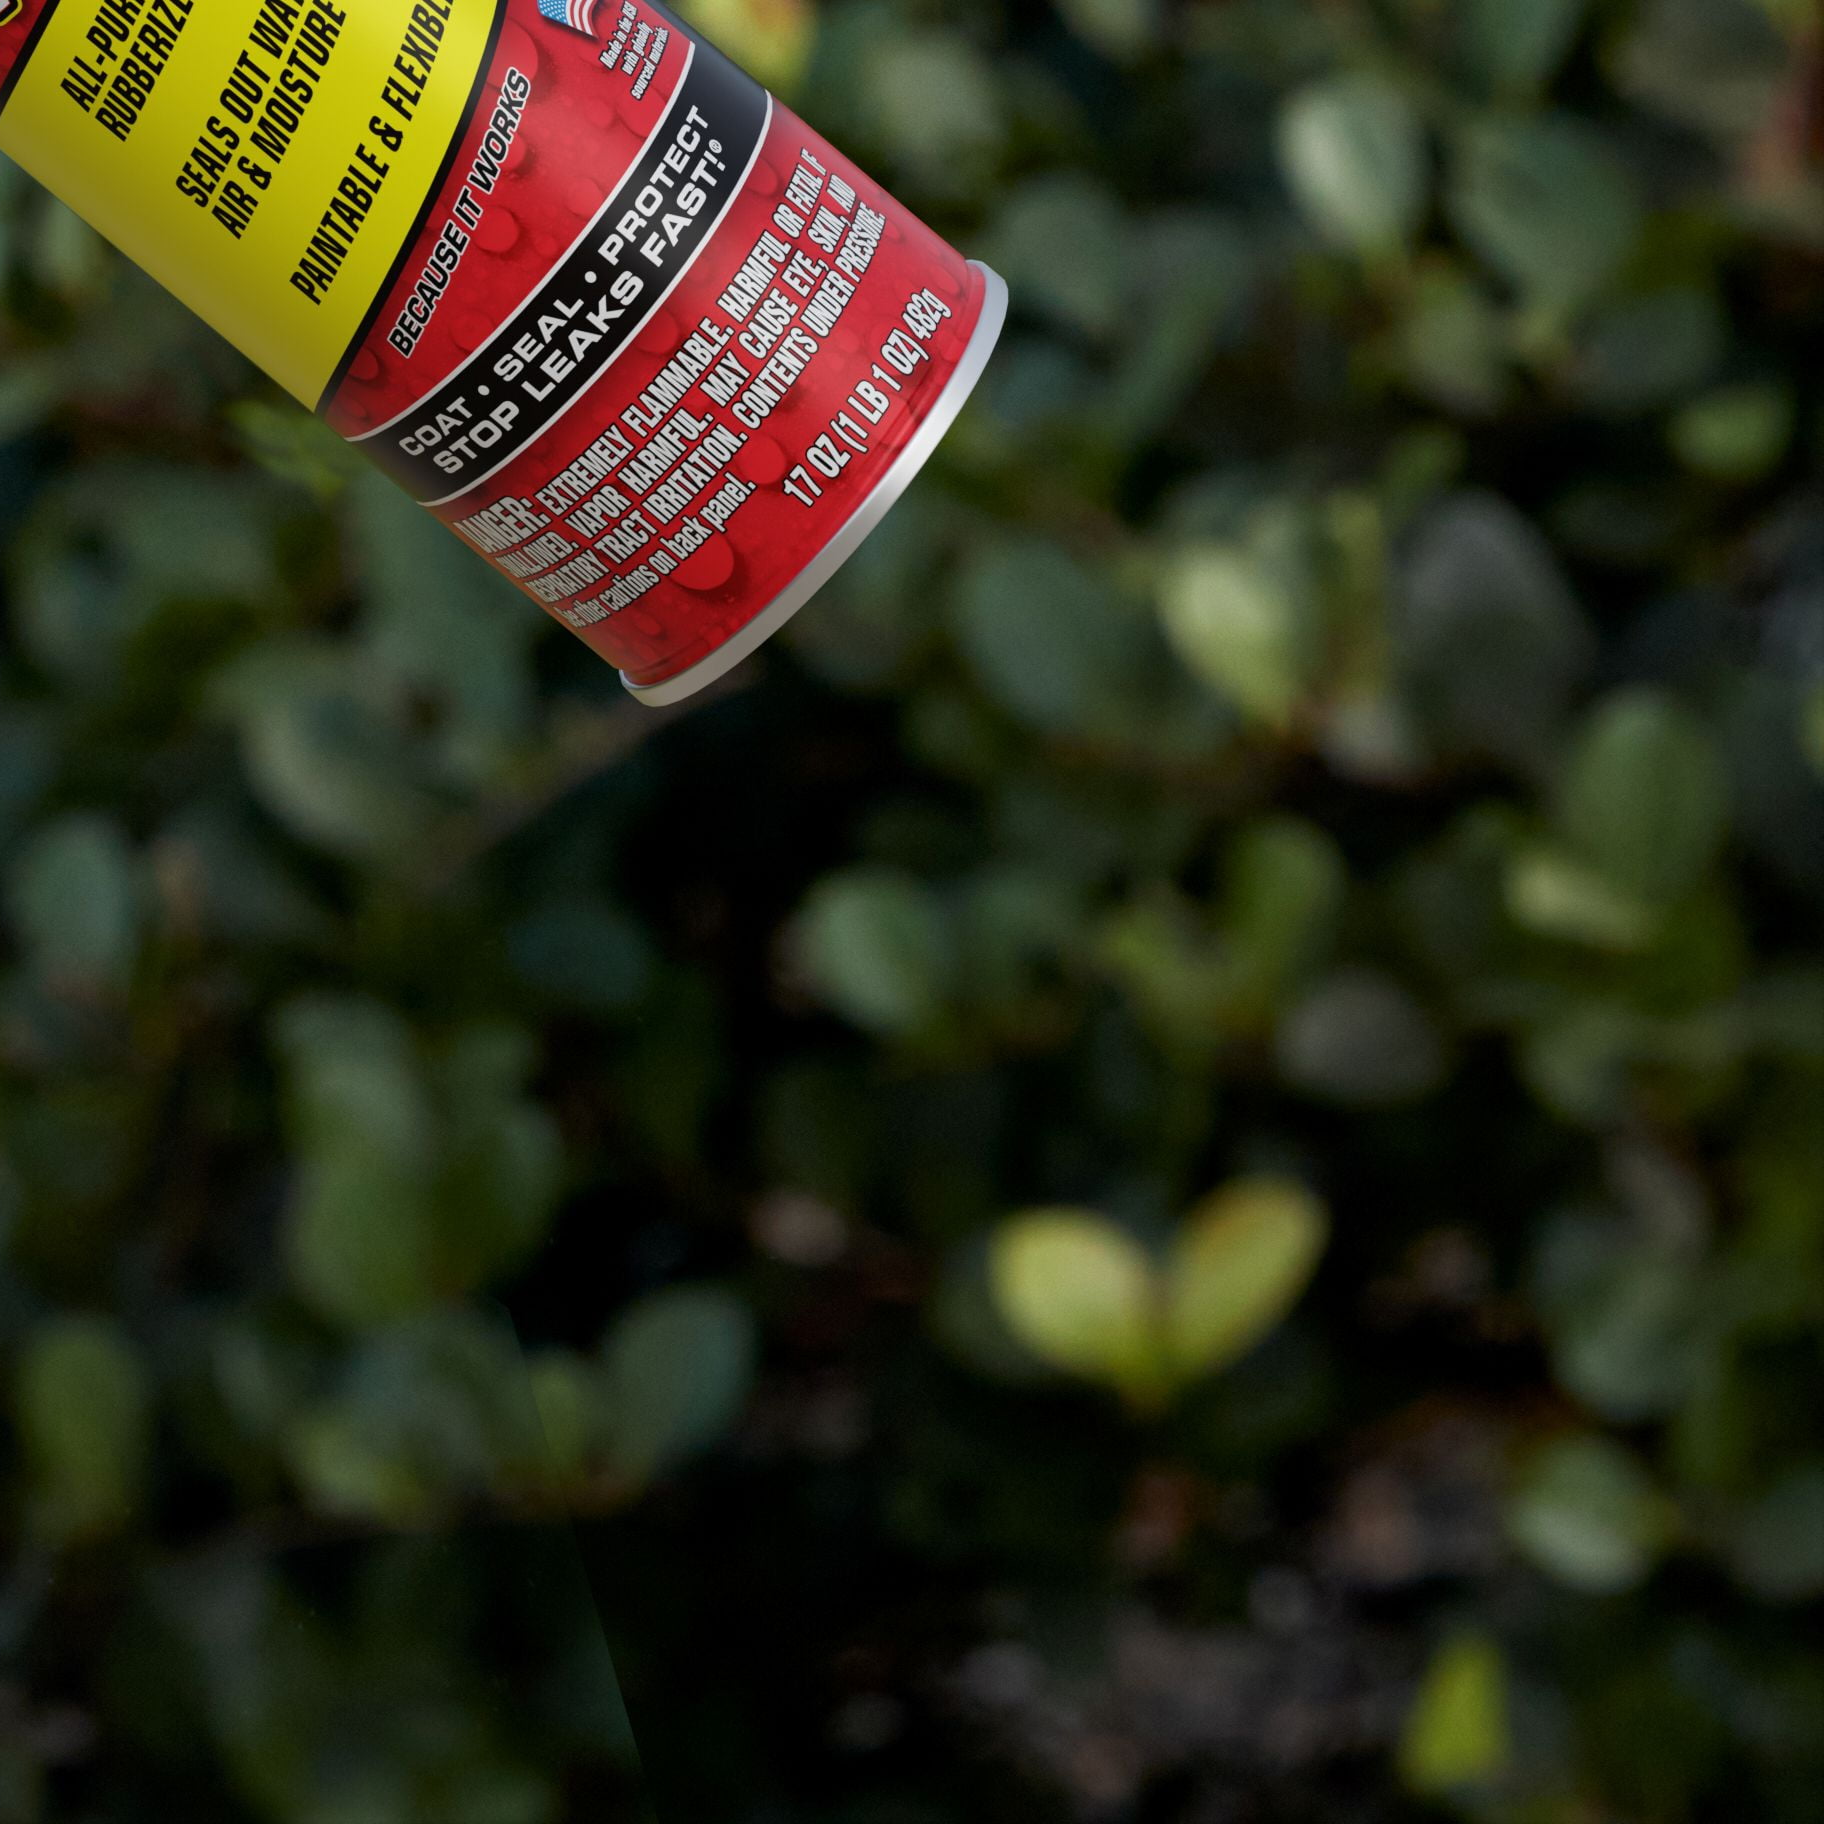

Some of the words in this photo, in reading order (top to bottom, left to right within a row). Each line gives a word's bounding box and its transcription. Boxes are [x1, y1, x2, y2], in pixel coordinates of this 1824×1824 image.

[612, 30, 628, 44] in
[617, 16, 633, 34] the
[630, 20, 654, 57] globally
[598, 39, 623, 70] Made
[621, 49, 640, 76] with
[631, 57, 657, 100] sourced
[175, 115, 240, 209] SEALS
[219, 49, 272, 124] OUT
[469, 66, 532, 196] WORKS
[800, 147, 827, 177] IF
[210, 186, 260, 241] AIR
[236, 155, 274, 191] &
[289, 142, 391, 306] PAINTABLE
[367, 115, 405, 153] &
[455, 188, 484, 234] IT
[783, 163, 825, 216] FATAL
[826, 173, 857, 216] AND
[771, 202, 806, 239] OR
[806, 204, 852, 254] SKIN,
[387, 219, 468, 359] BECAUSE
[399, 396, 474, 457] COAT
[493, 296, 585, 382] SEAL
[598, 105, 711, 266] PROTECT
[717, 229, 792, 321] HARMFUL
[780, 248, 830, 299] EYE,
[738, 287, 799, 360] CAUSE
[899, 287, 953, 341] 482g
[433, 400, 520, 474] STOP
[521, 270, 645, 403] LEAKS
[880, 327, 931, 376] OZ)
[524, 548, 611, 604] RESPIRATORY
[593, 509, 658, 565] TRACT
[641, 423, 749, 525] IRRITATION.
[731, 326, 820, 430] CONTENTS
[799, 269, 861, 338] UNDER
[833, 200, 887, 284] PRESSURE.
[619, 316, 736, 438] FLAMMABLE.
[699, 349, 751, 408] MAY
[871, 363, 902, 392] 1
[847, 379, 890, 427] LB
[617, 407, 715, 496] HARMFUL.
[805, 432, 852, 479] OZ
[829, 411, 869, 454] (1
[534, 423, 635, 517] EXTREMELY
[782, 464, 823, 508] 17
[453, 495, 552, 554] DANGER:
[563, 484, 633, 539] VAPOR
[699, 471, 757, 533] panel.
[648, 548, 679, 576] on
[659, 516, 713, 561] back
[598, 564, 661, 613] cautions
